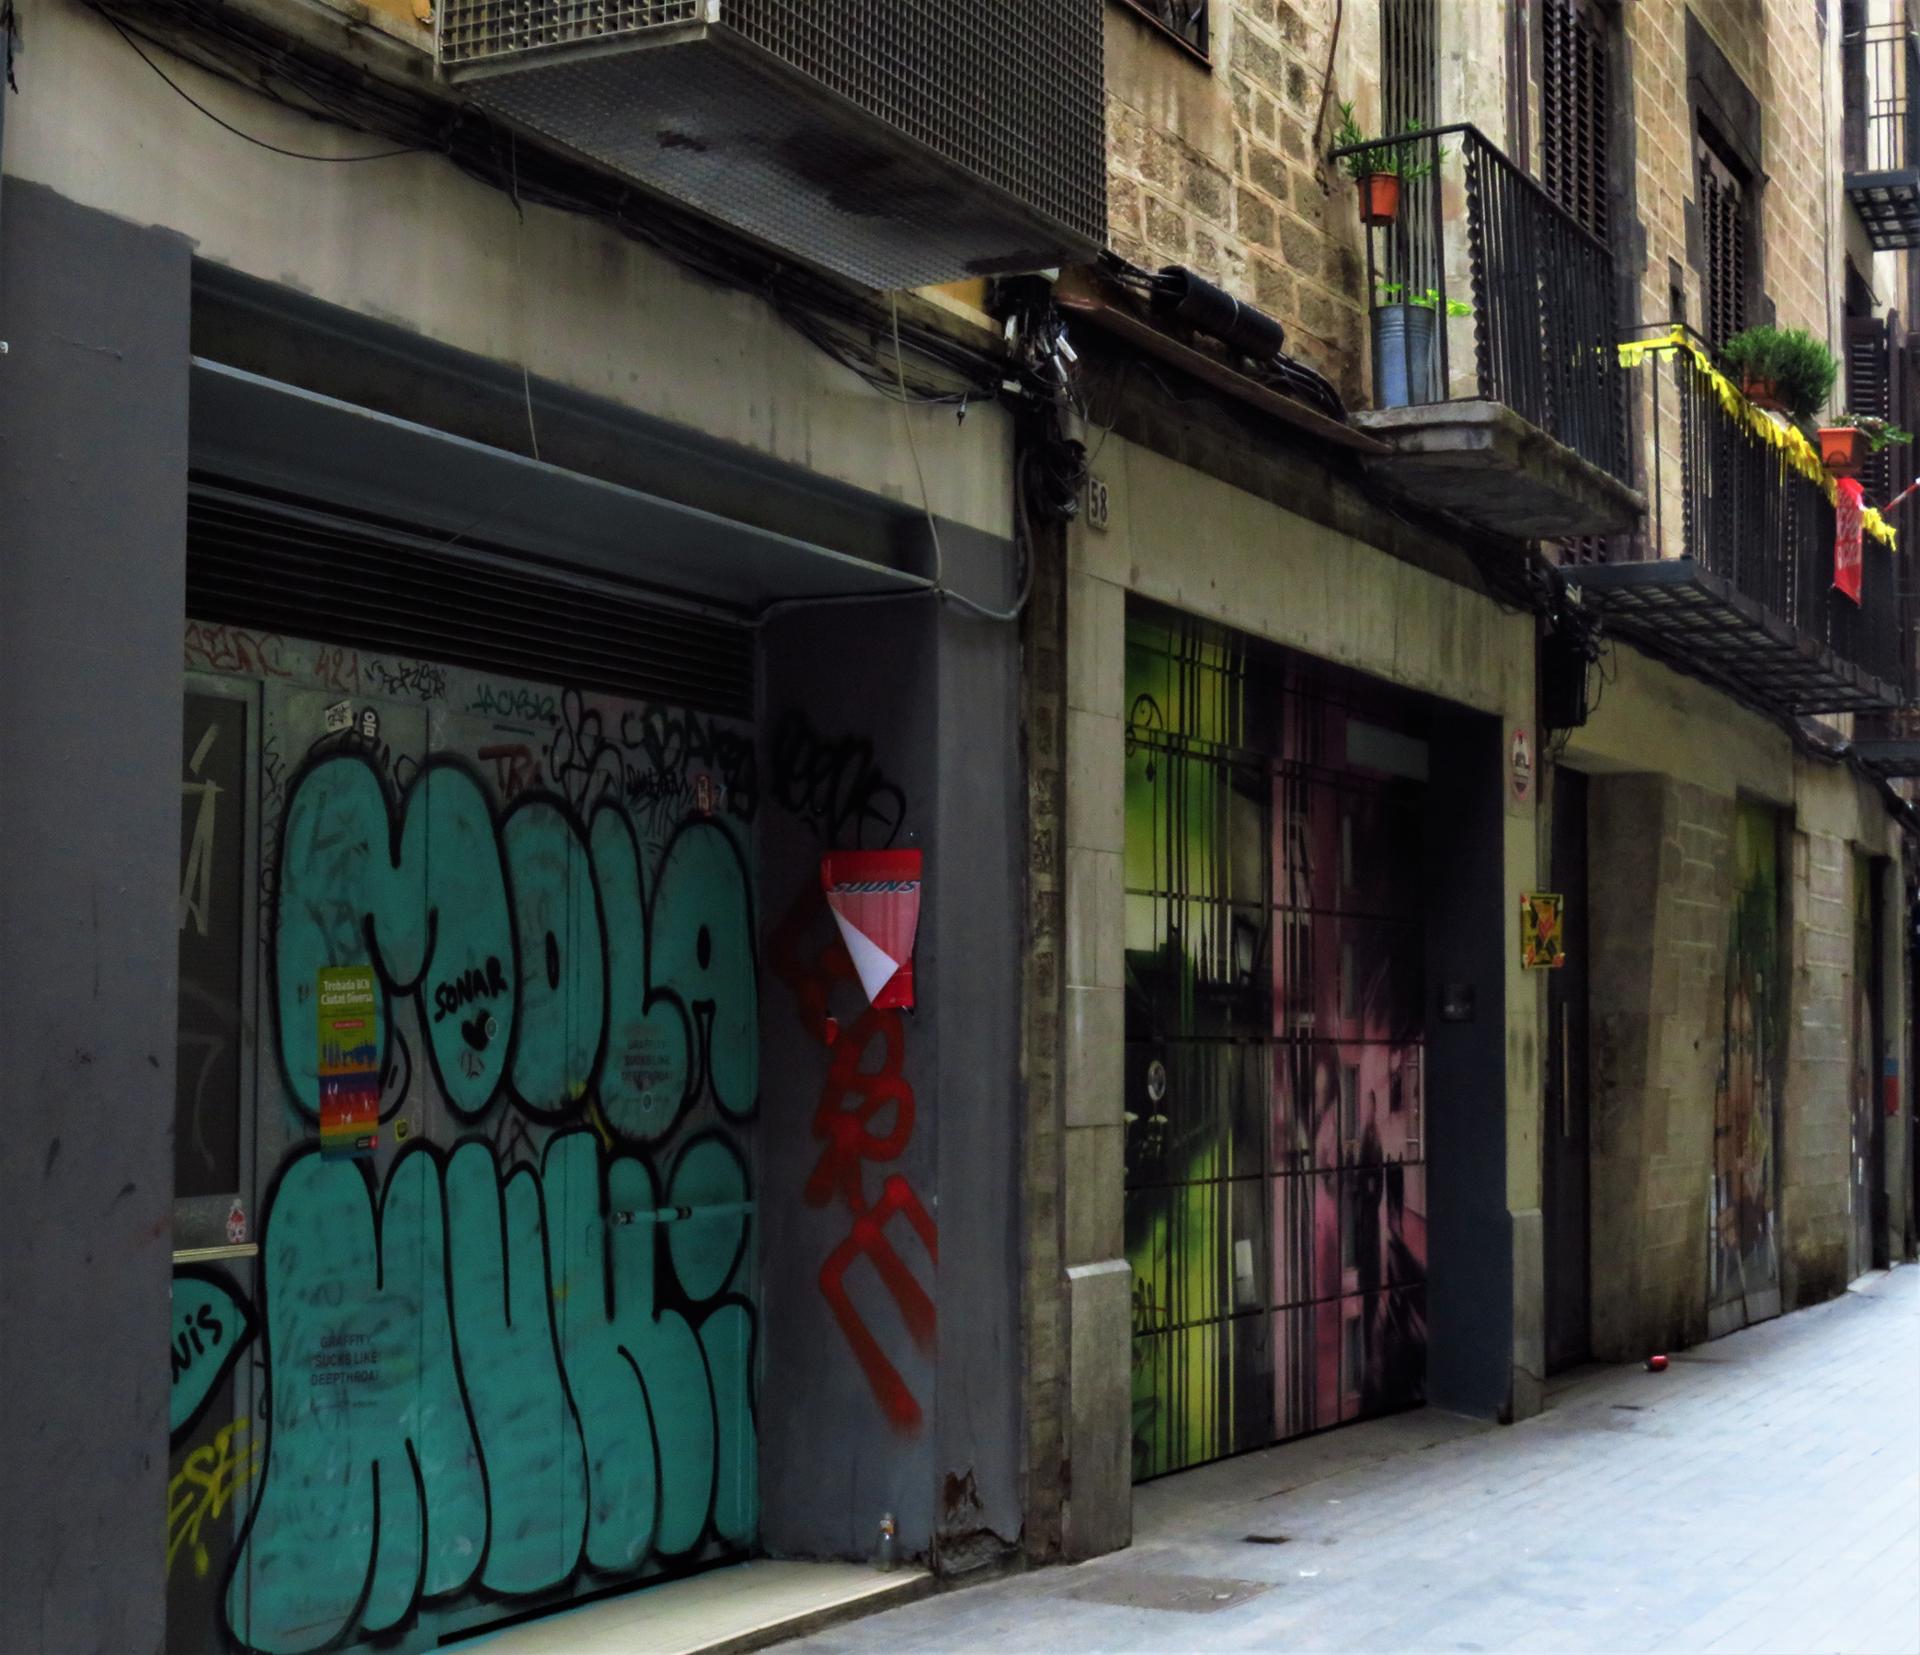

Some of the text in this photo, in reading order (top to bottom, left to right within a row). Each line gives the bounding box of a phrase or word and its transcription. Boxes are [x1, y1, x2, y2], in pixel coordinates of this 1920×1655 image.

[1091, 480, 1107, 522] 58
[323, 979, 355, 991] Trobada
[435, 956, 507, 1022] SONAR
[321, 992, 346, 1005] Ciutat
[315, 1351, 378, 1368] SUCKS LIKE
